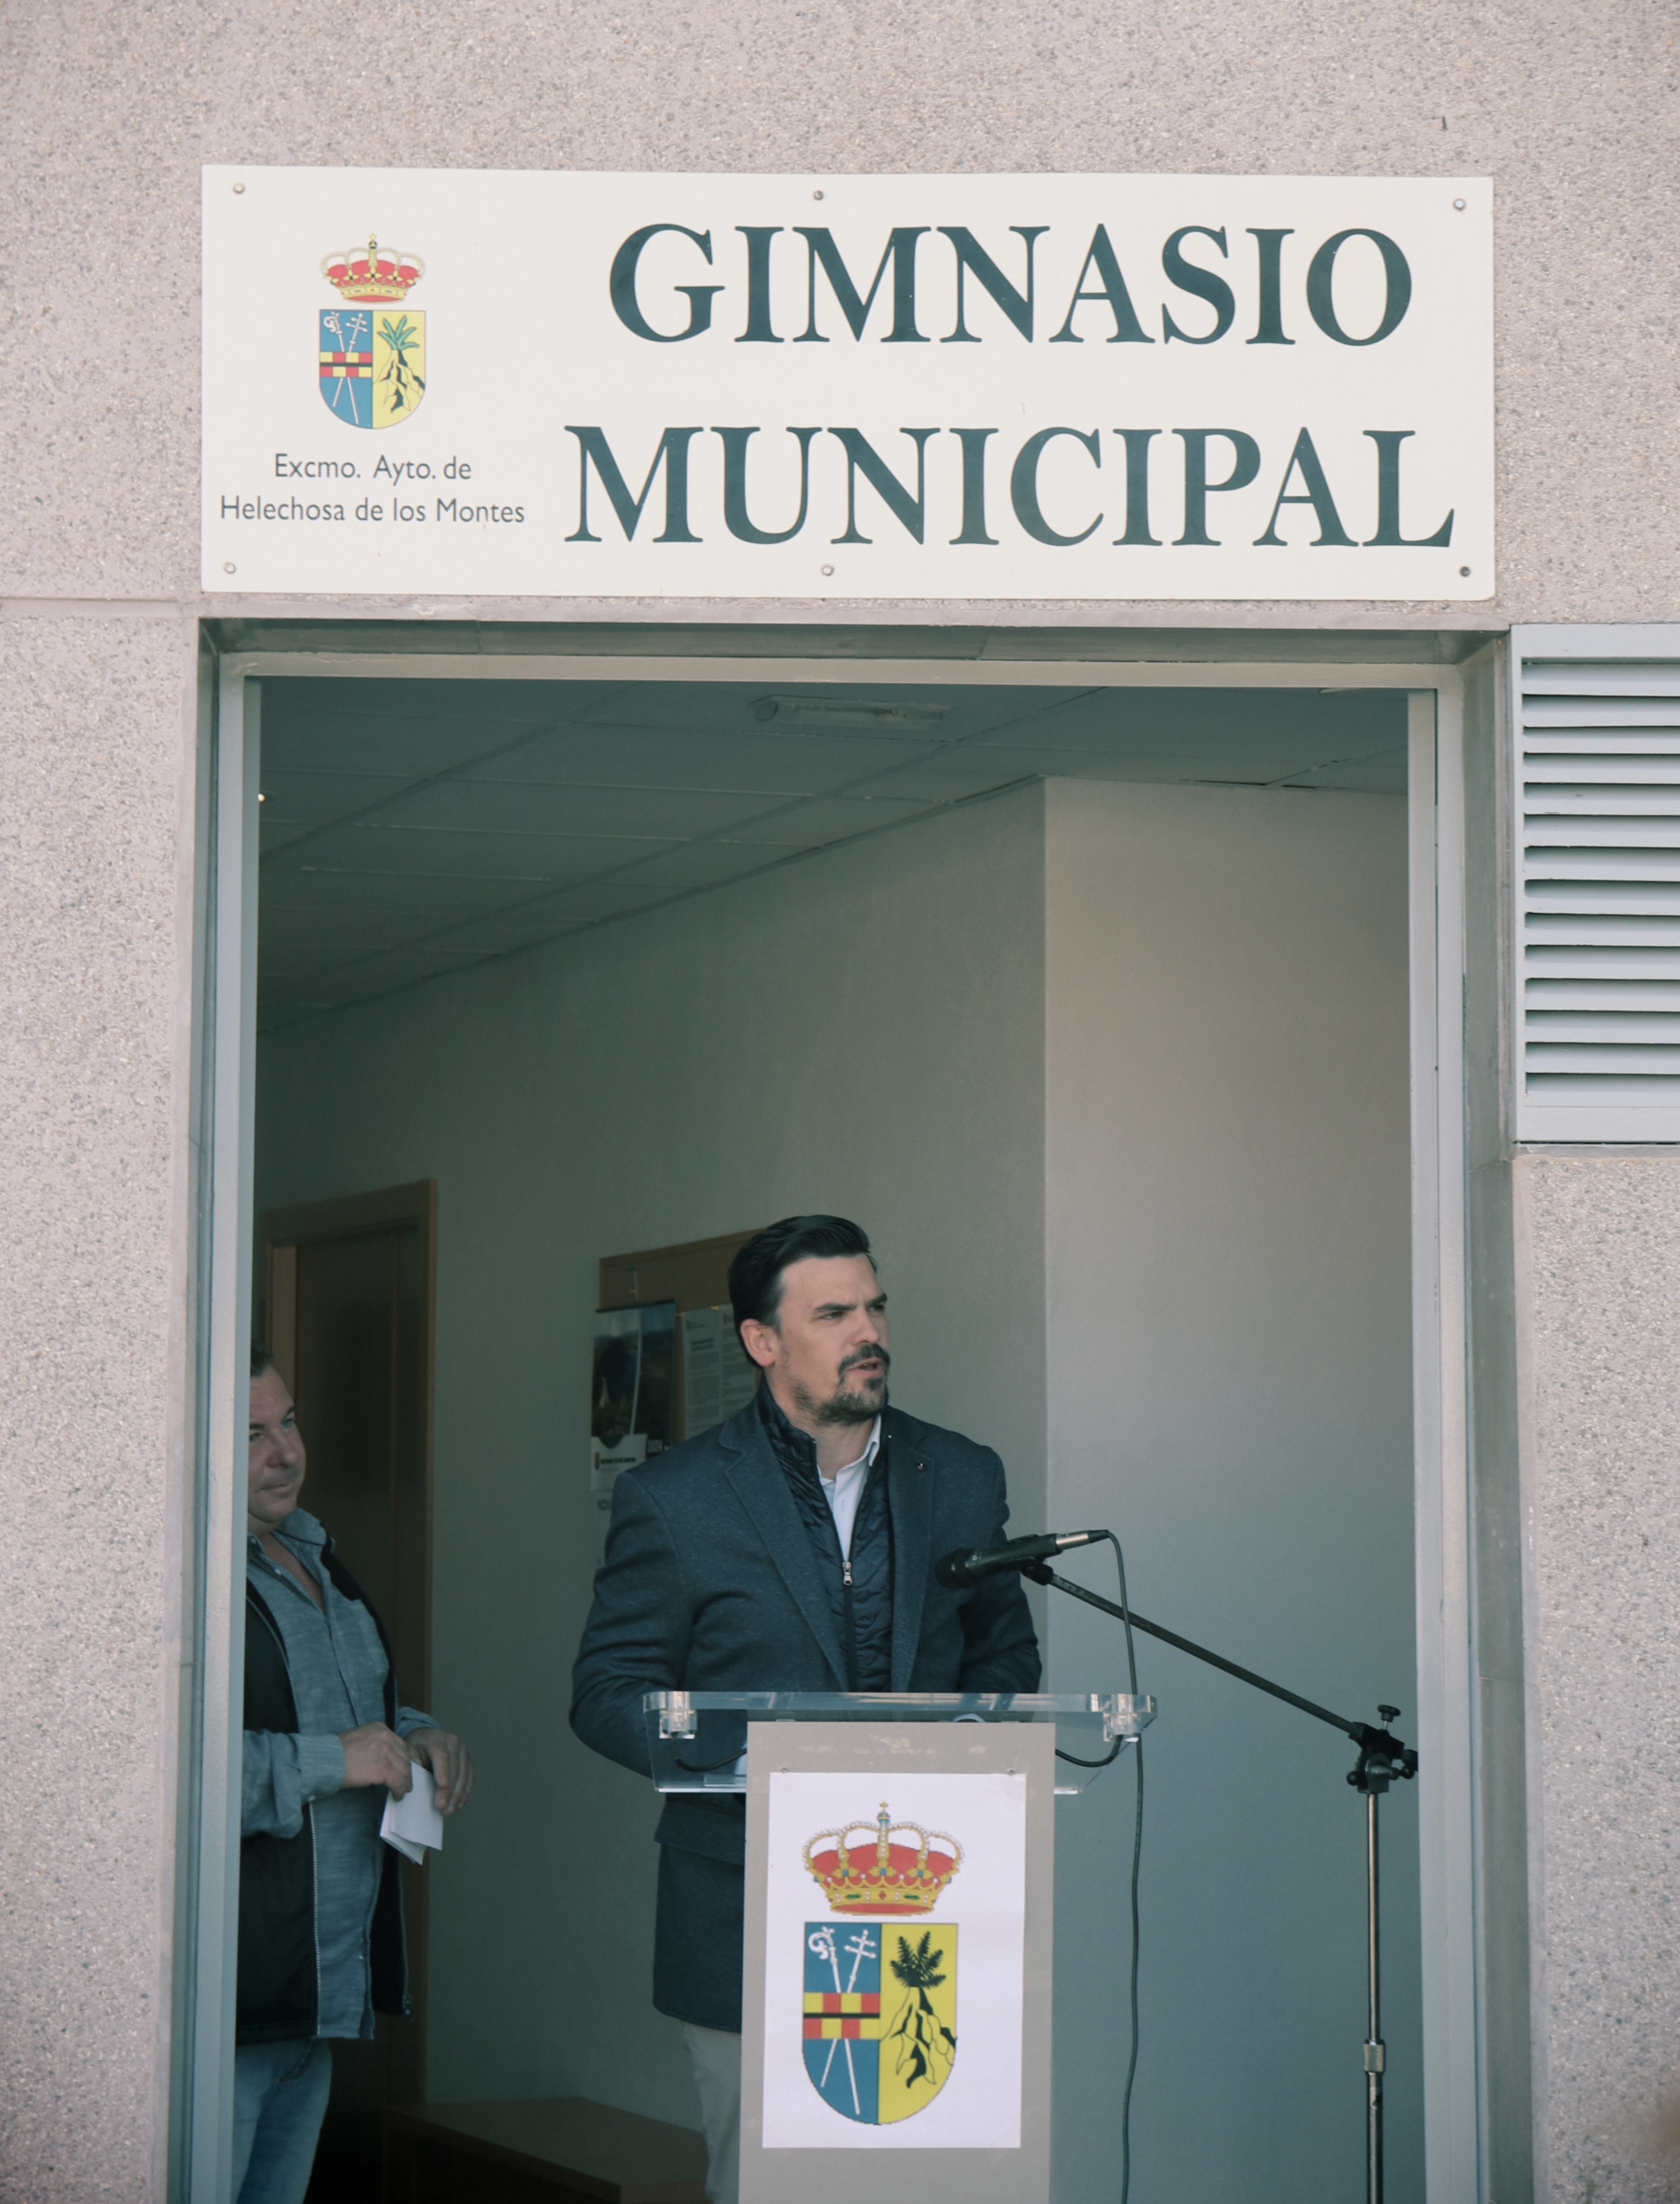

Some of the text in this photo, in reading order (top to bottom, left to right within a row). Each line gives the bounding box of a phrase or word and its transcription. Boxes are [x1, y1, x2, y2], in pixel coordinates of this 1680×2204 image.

[609, 223, 1412, 347] GIMNASIO
[275, 453, 471, 486] Excmo. Ayto. de
[564, 425, 1454, 548] MUNICIPAL
[221, 495, 525, 523] Helechosa de los Montes
